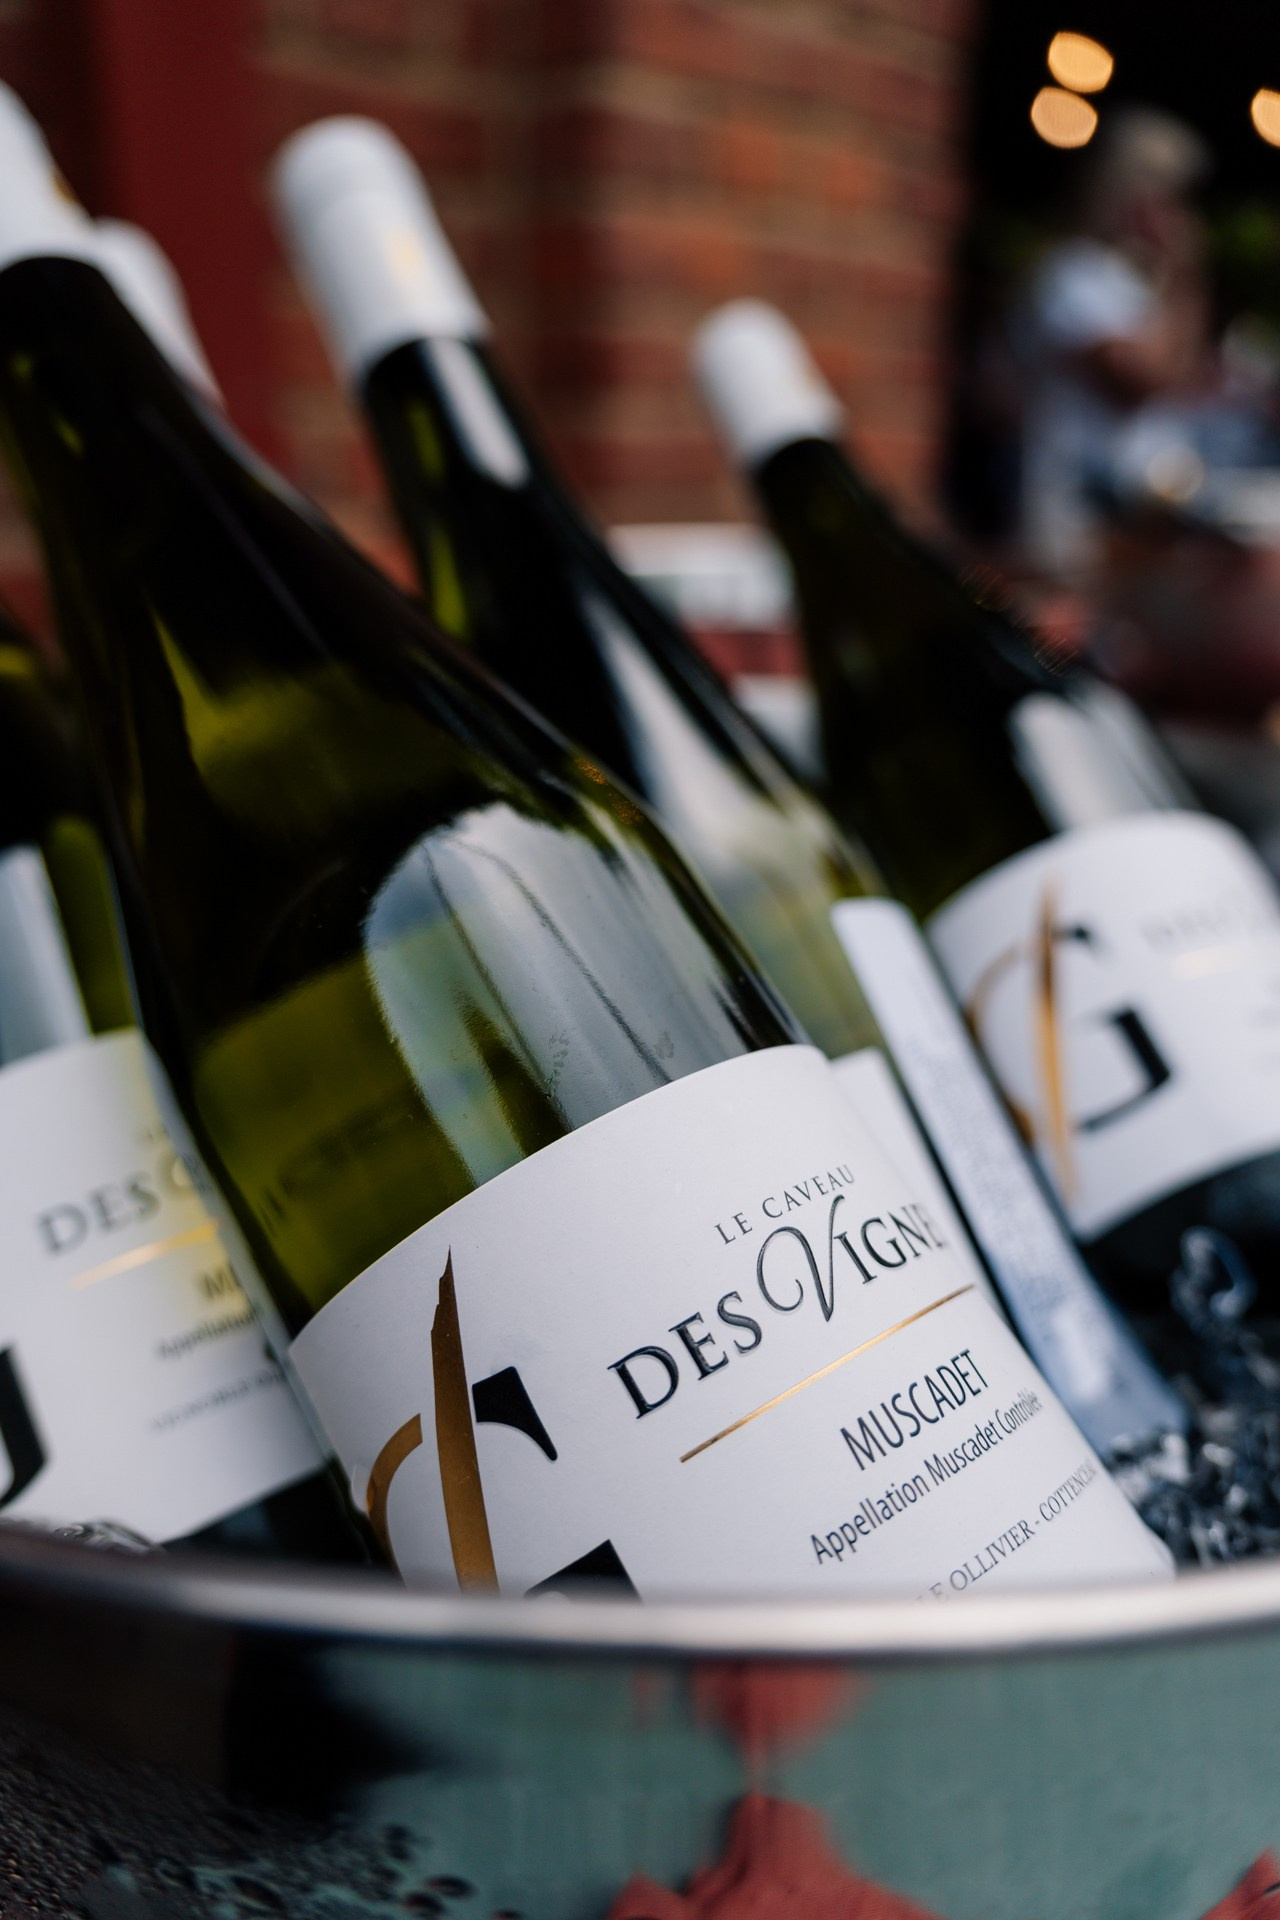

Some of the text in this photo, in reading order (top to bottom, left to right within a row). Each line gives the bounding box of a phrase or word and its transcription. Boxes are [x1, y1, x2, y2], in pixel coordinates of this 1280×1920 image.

[714, 1164, 855, 1245] LE CAVEAU
[607, 1290, 763, 1419] DES
[840, 1348, 989, 1471] MUSCADET
[810, 1473, 931, 1565] Appellation
[924, 1420, 1004, 1486] Muscadet
[949, 1519, 1036, 1591] OLLIVIER
